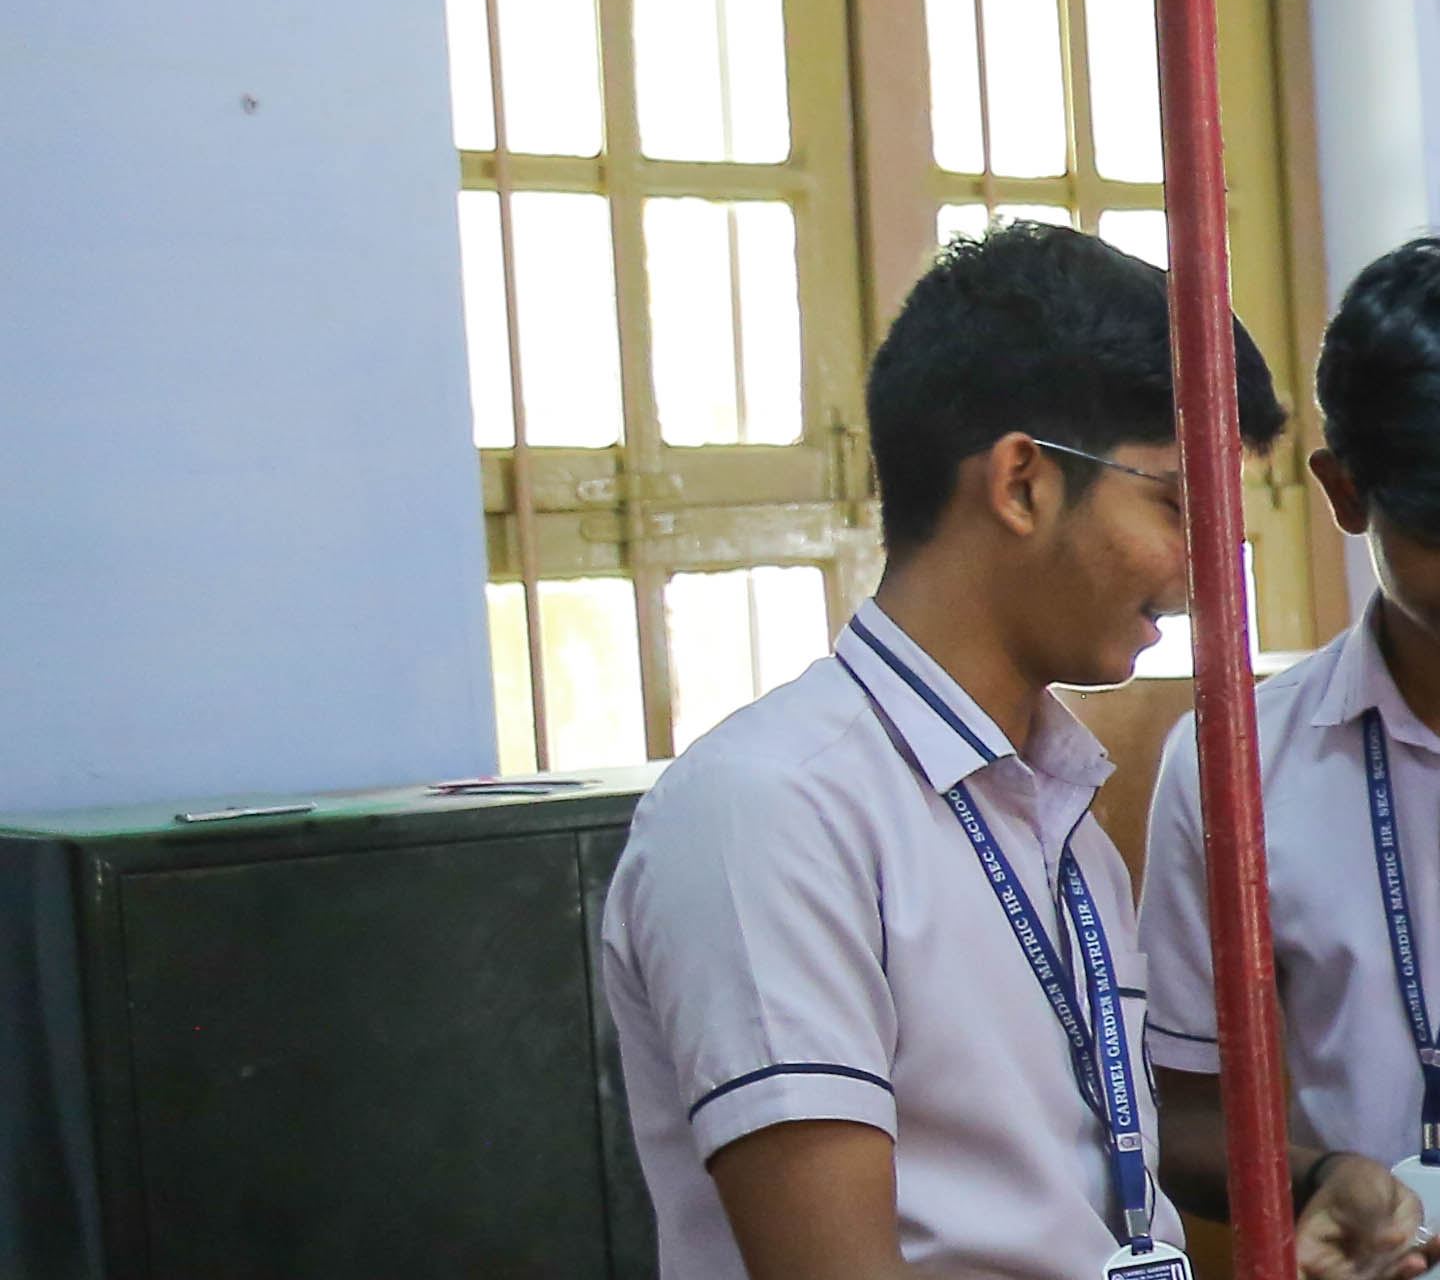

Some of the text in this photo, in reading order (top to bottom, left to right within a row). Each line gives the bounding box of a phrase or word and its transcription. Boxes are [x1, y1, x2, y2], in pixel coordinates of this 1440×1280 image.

[983, 846, 1006, 882] SEC.
[1383, 851, 1404, 911] MATRIC
[1002, 884, 1022, 915] HR.
[1078, 900, 1095, 927] HR.
[1015, 918, 1054, 980] MATRIC
[1085, 930, 1110, 993] MATRIC
[1394, 914, 1415, 976] GARDEN
[1047, 982, 1085, 1048] GARDEN
[1100, 994, 1121, 1058] GARDEN
[1110, 1060, 1132, 1127] CARMEL
